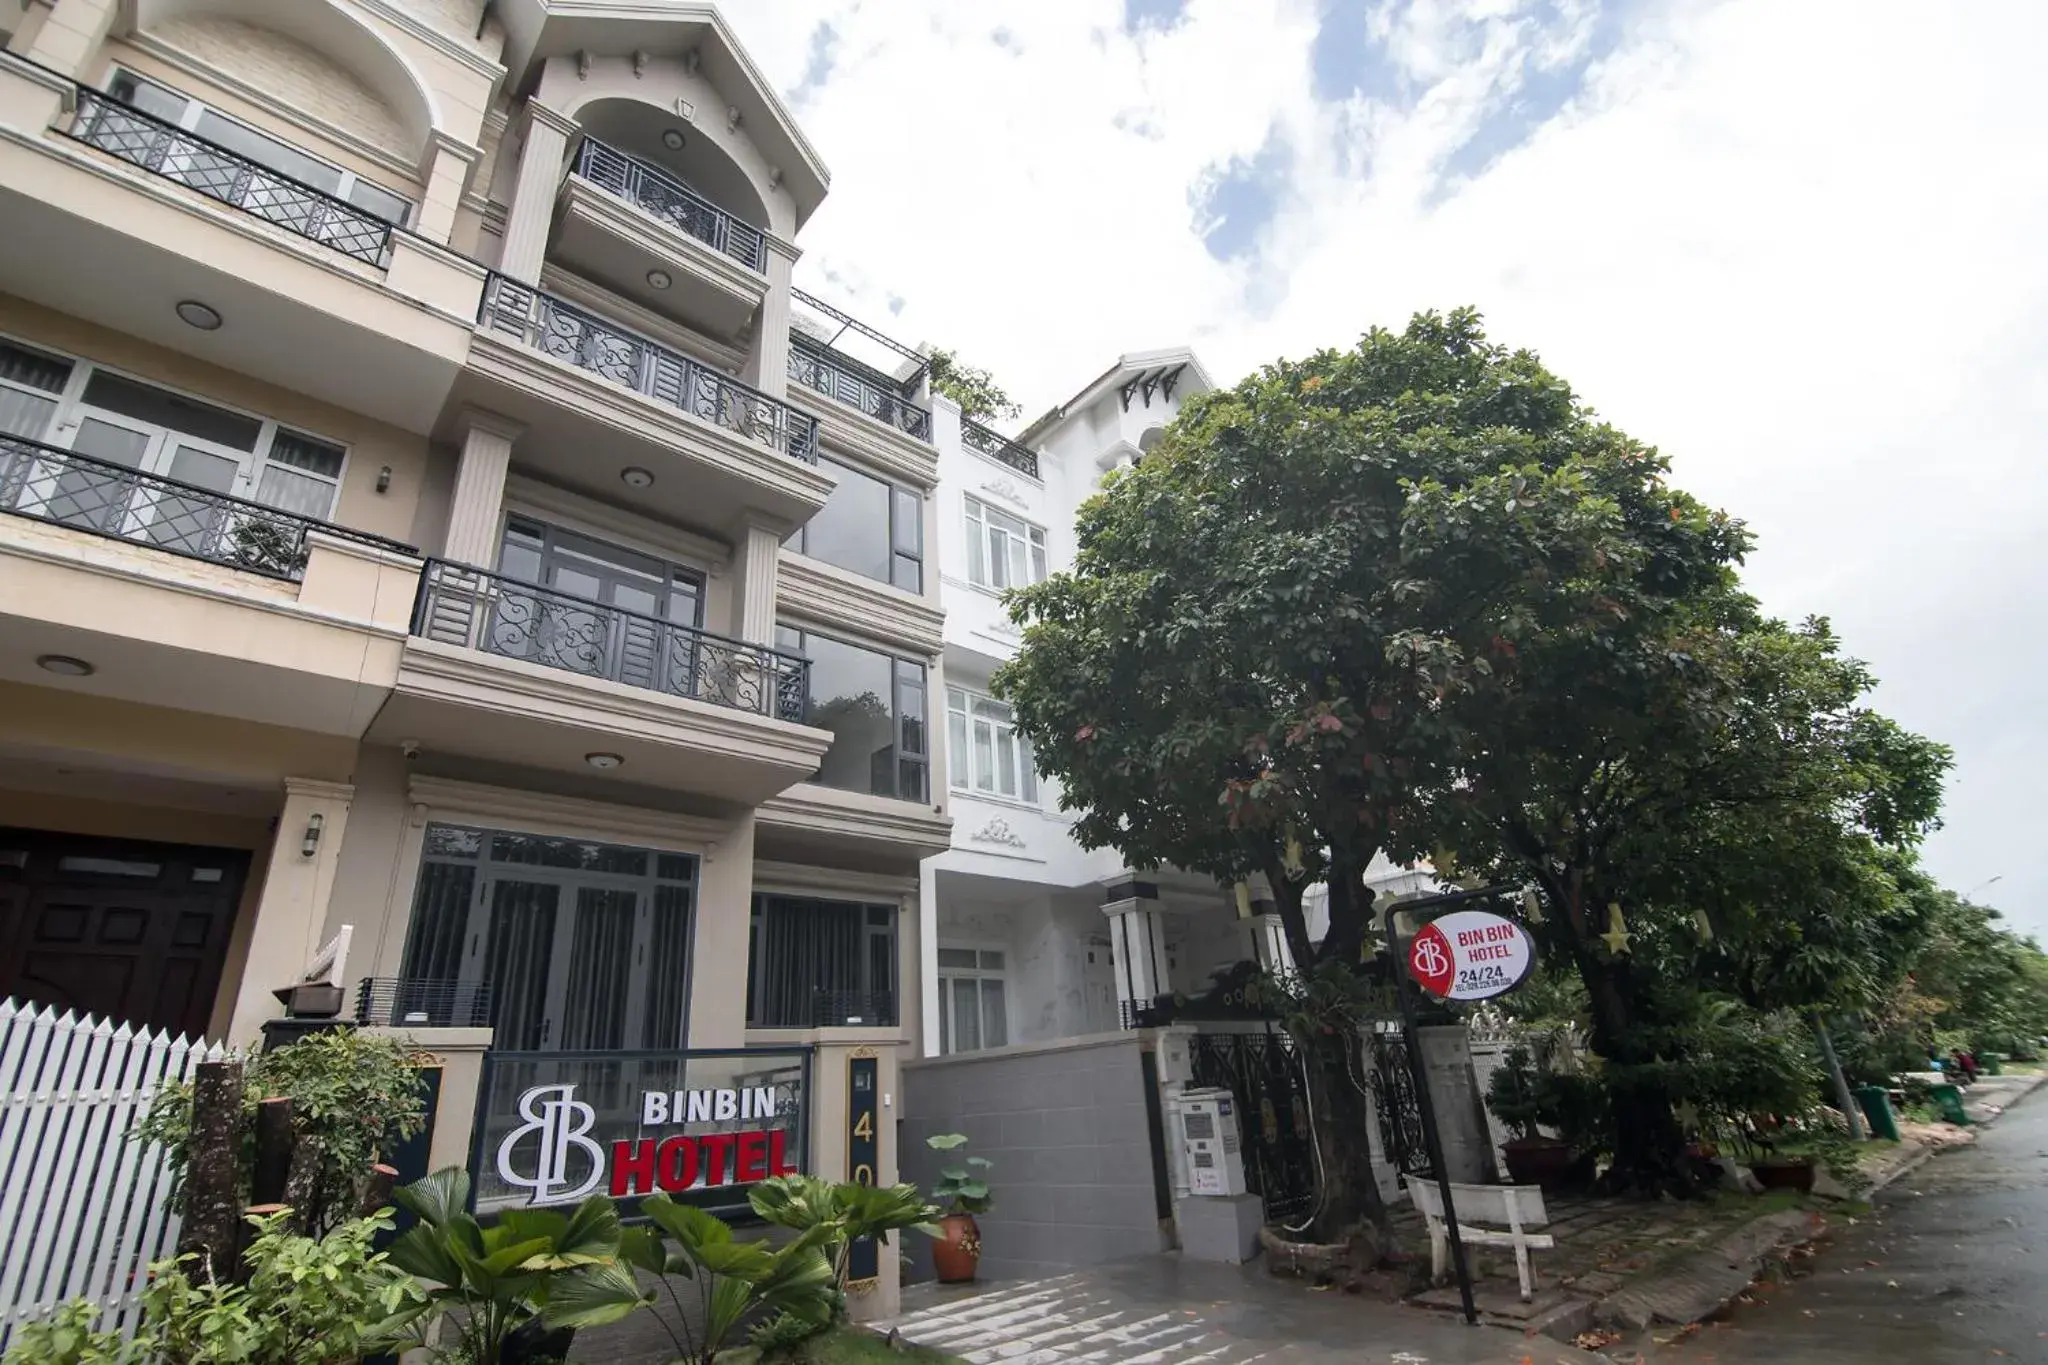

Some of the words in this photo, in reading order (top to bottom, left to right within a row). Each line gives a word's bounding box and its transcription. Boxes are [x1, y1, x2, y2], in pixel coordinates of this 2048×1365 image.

[1458, 929, 1485, 946] BIN
[1486, 924, 1514, 942] BIN
[1468, 944, 1512, 962] HOTEL
[1460, 965, 1503, 983] 24/24
[642, 1086, 776, 1126] BINBIN
[609, 1128, 799, 1197] HOTEL
